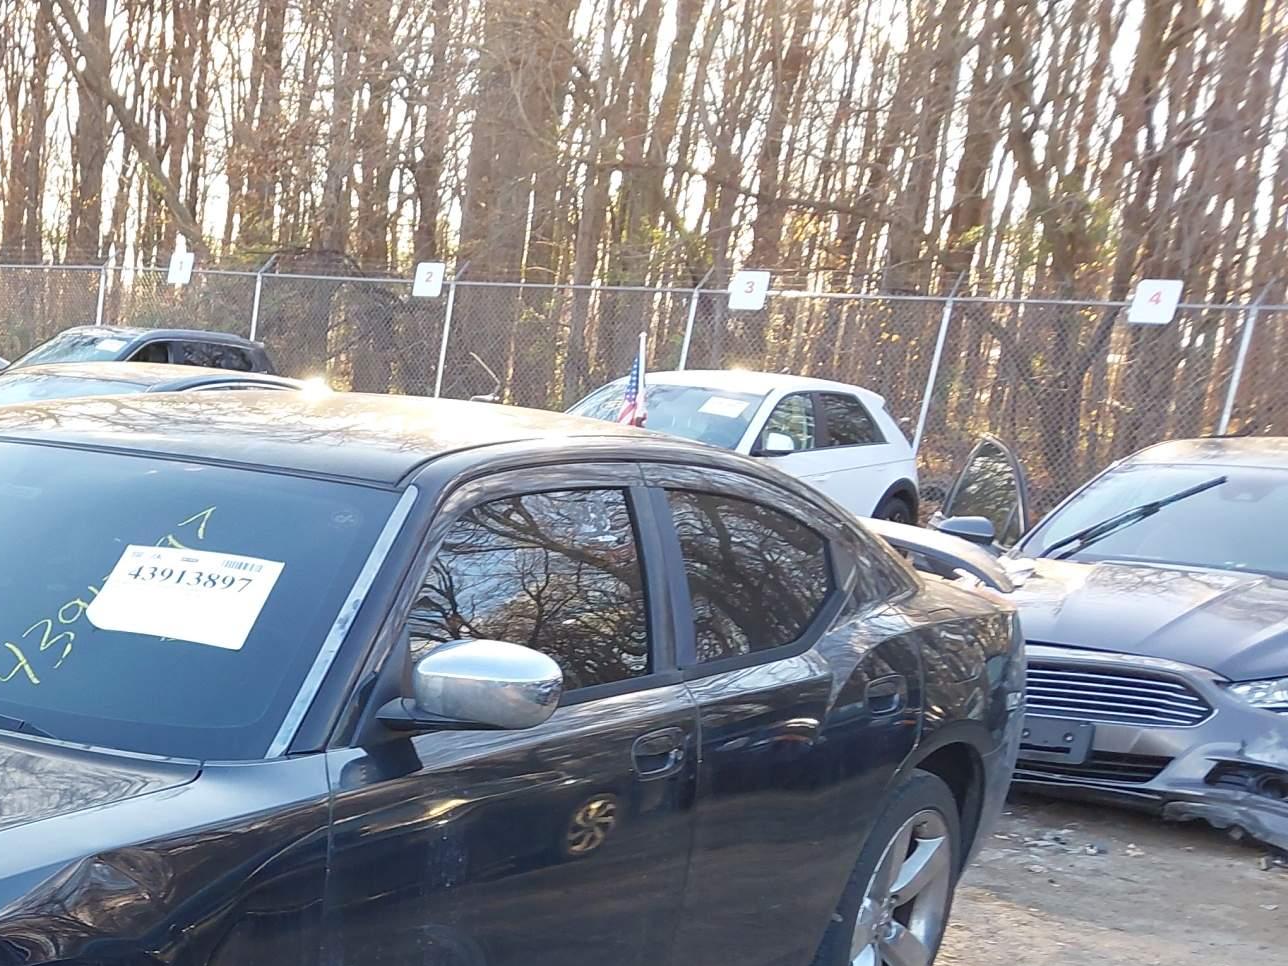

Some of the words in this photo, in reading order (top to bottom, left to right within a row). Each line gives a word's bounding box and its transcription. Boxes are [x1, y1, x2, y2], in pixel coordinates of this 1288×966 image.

[424, 271, 434, 283] 2
[743, 280, 755, 294] 3
[1147, 290, 1162, 305] 4
[127, 564, 253, 593] 43913897
